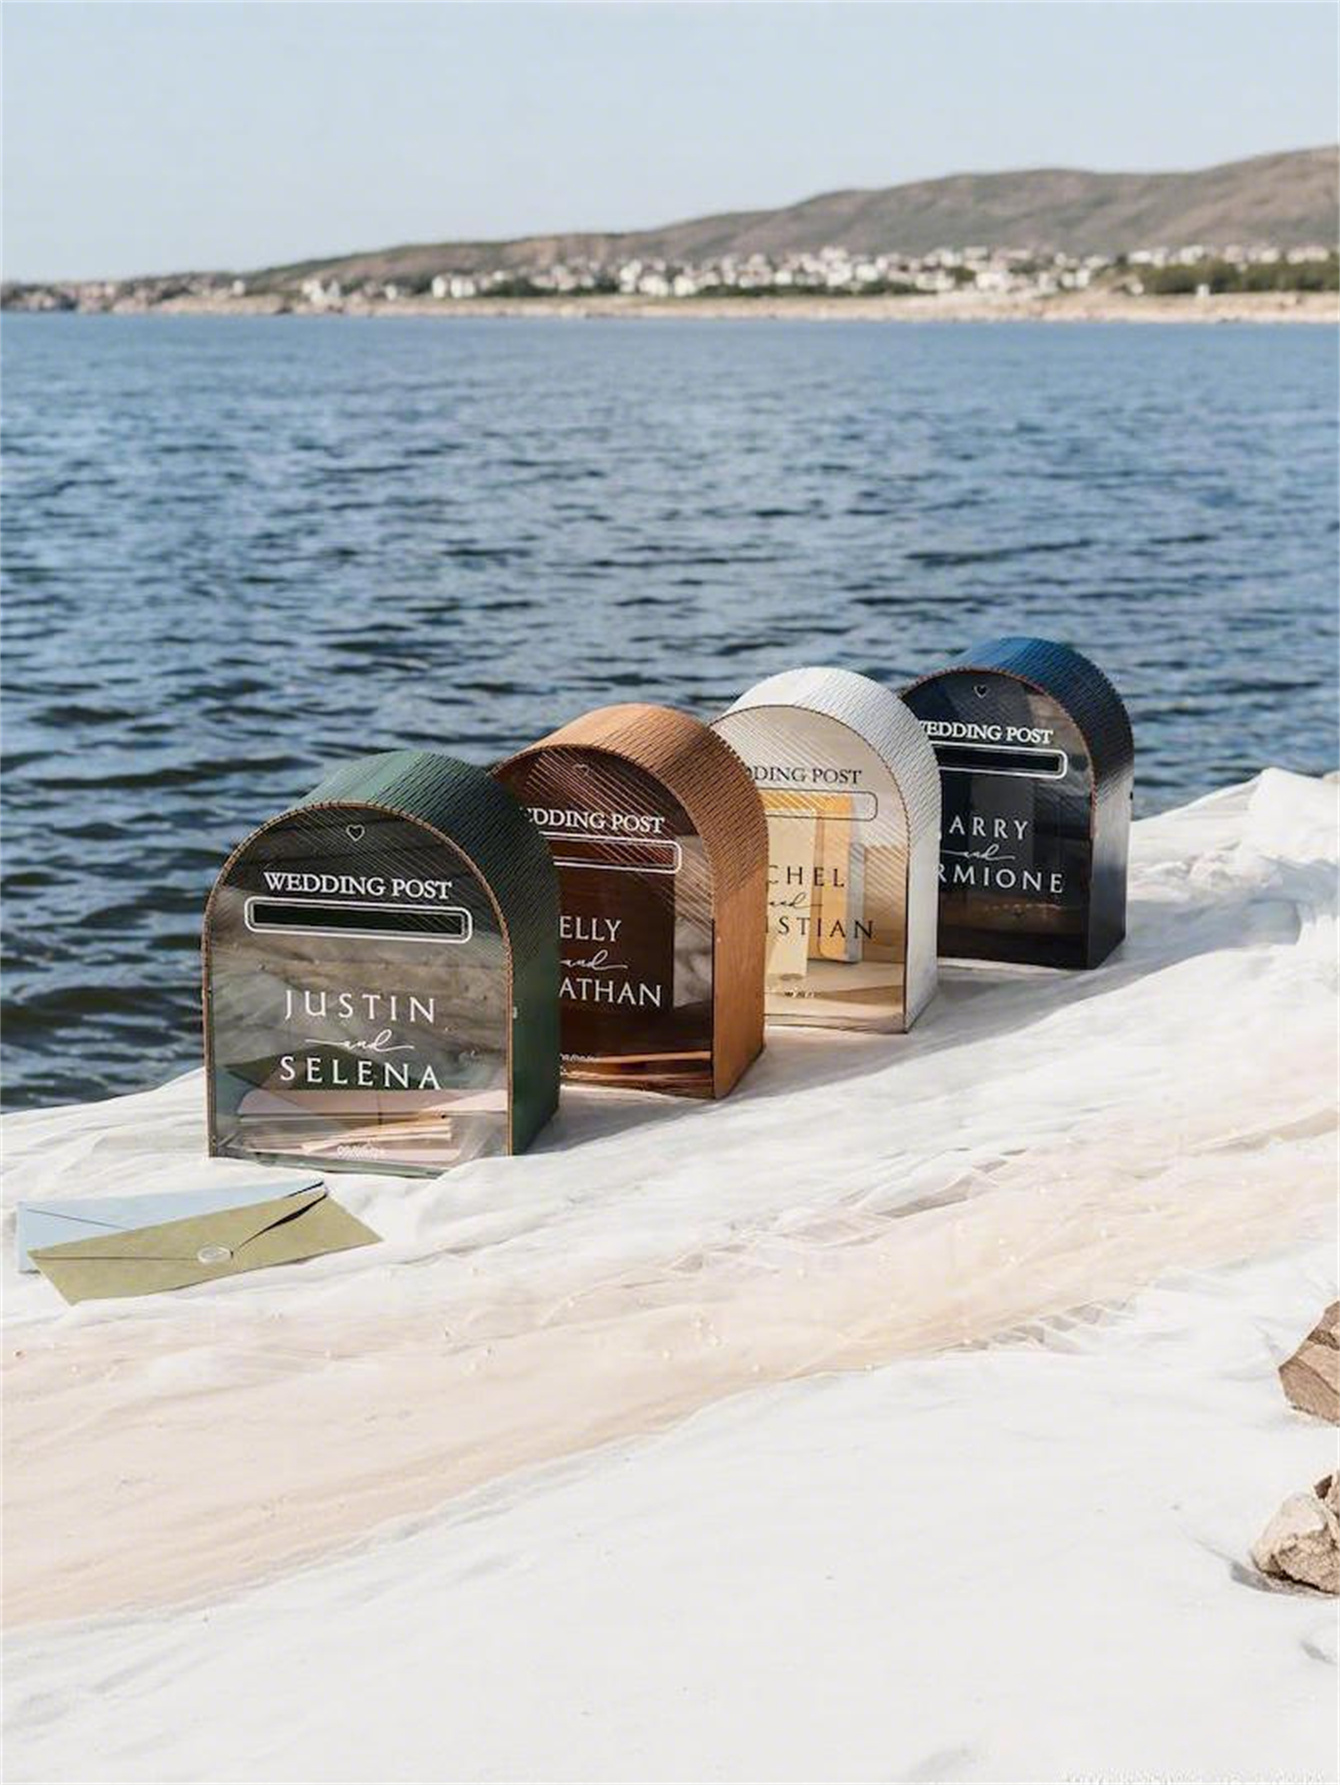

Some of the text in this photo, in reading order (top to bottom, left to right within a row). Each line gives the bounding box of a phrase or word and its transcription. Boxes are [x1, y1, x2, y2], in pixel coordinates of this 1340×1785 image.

[1005, 726, 1054, 744] POST
[812, 768, 862, 784] POST
[527, 807, 665, 834] DDING POST
[949, 815, 1029, 840] ARRY
[940, 843, 1016, 861] and
[263, 871, 453, 900] WEDDING POST
[559, 915, 622, 942] ELLY
[560, 949, 628, 971] and
[558, 976, 662, 1007] ATHAN
[284, 989, 435, 1023] JUSTIN
[304, 1029, 415, 1053] and
[279, 1055, 441, 1091] SELENA
